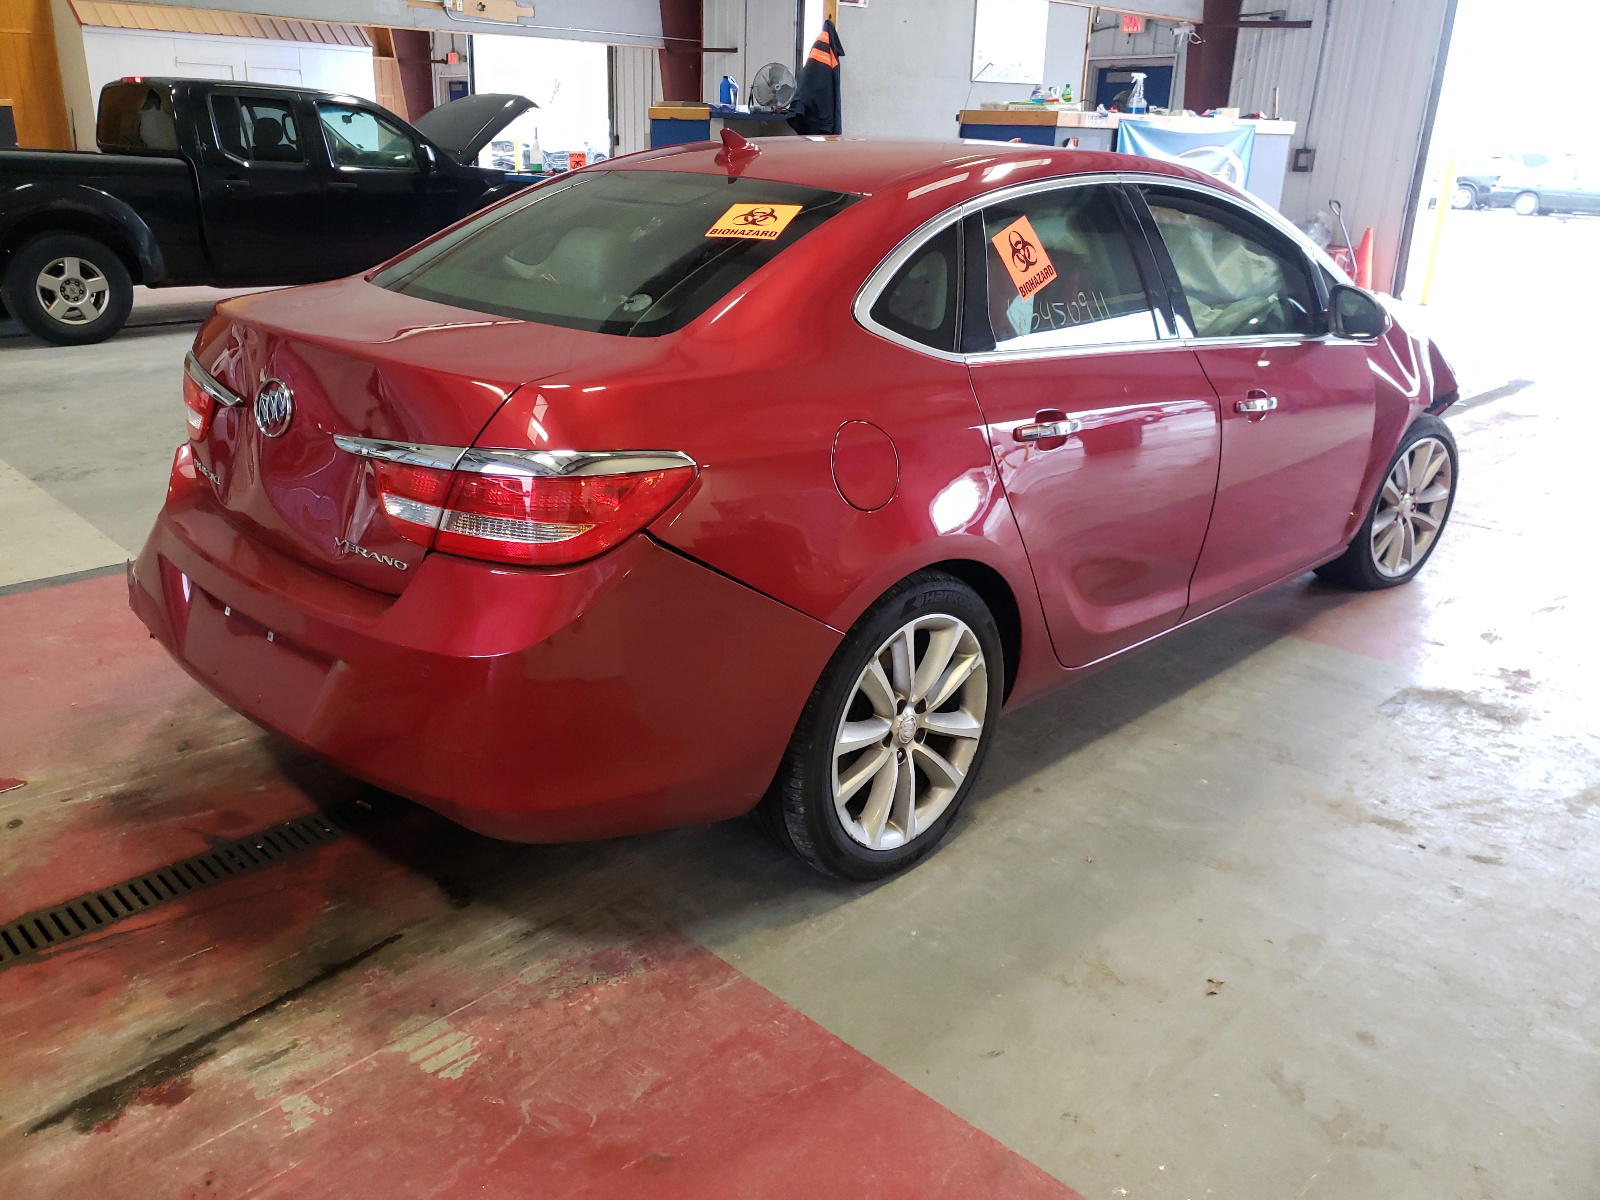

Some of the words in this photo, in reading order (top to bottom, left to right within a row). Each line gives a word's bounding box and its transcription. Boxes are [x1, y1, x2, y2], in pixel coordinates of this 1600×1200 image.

[709, 228, 778, 237] BIOHAZARD
[1019, 264, 1055, 298] BIOHAZARD
[334, 536, 408, 571] VERANO
